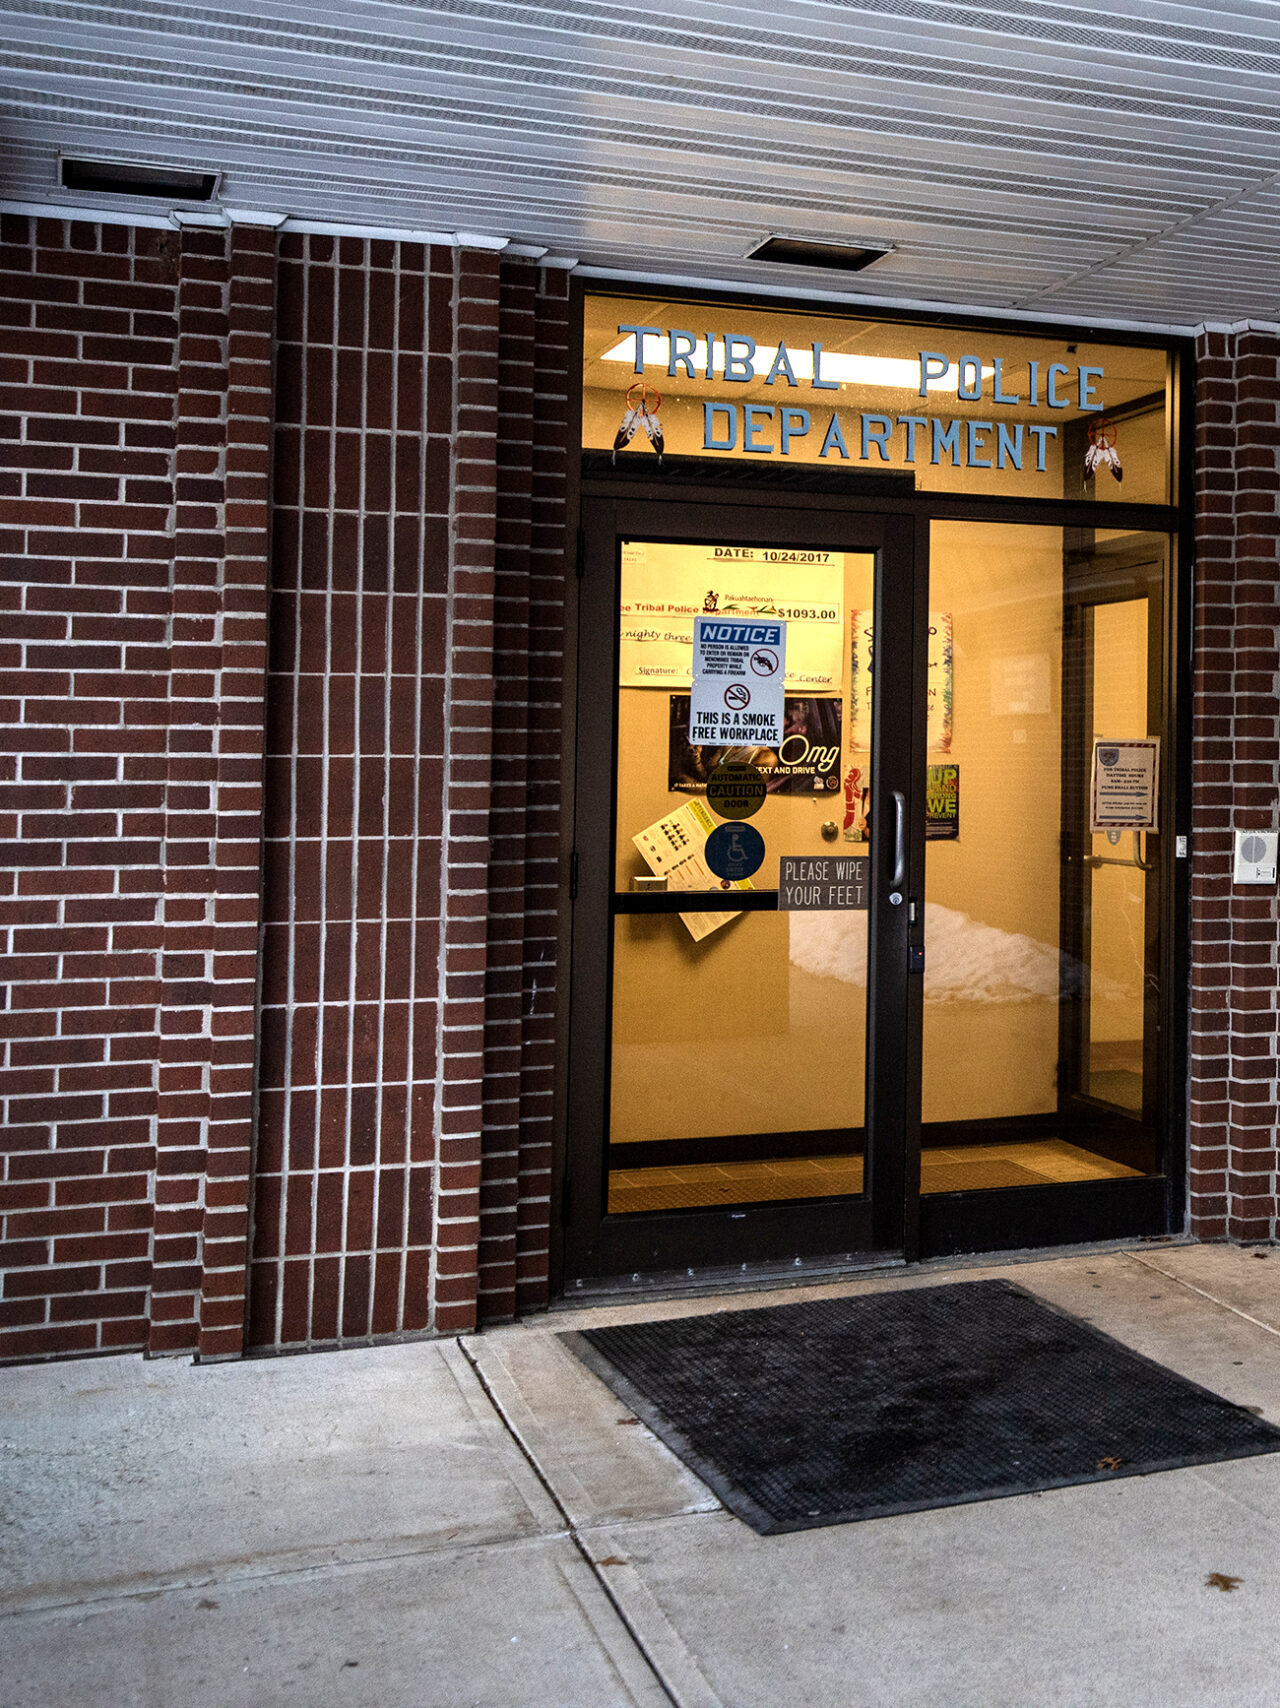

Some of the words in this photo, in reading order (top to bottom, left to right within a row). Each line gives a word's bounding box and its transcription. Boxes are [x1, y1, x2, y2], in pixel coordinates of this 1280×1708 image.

[618, 325, 840, 389] TRIBAL
[919, 351, 1104, 411] POLICE
[702, 402, 1057, 471] DEPARTMENT
[714, 548, 754, 558] DATE:
[763, 551, 830, 563] 10/24/2017
[635, 603, 665, 612] Tribal
[668, 604, 699, 614] Police
[778, 609, 836, 620] $1093.00
[702, 625, 778, 643] NOTICE
[638, 666, 679, 676] Signature:
[696, 712, 719, 725] THIS
[722, 712, 731, 725] IS
[733, 713, 740, 726] A
[742, 713, 776, 727] SMOKE
[692, 726, 717, 740] FREE
[720, 727, 779, 741] WORKPLACE
[778, 734, 840, 773] Omg
[711, 773, 763, 782] AUTOMATIC
[774, 766, 791, 774] AND
[792, 766, 816, 774] DRIVE
[710, 785, 764, 796] CAUTION
[724, 799, 749, 808] DOOR
[927, 798, 957, 813] WE
[785, 862, 829, 881] PLEASE
[835, 862, 863, 881] WIPE
[785, 886, 821, 905] YOUR
[828, 886, 863, 905] FEET
